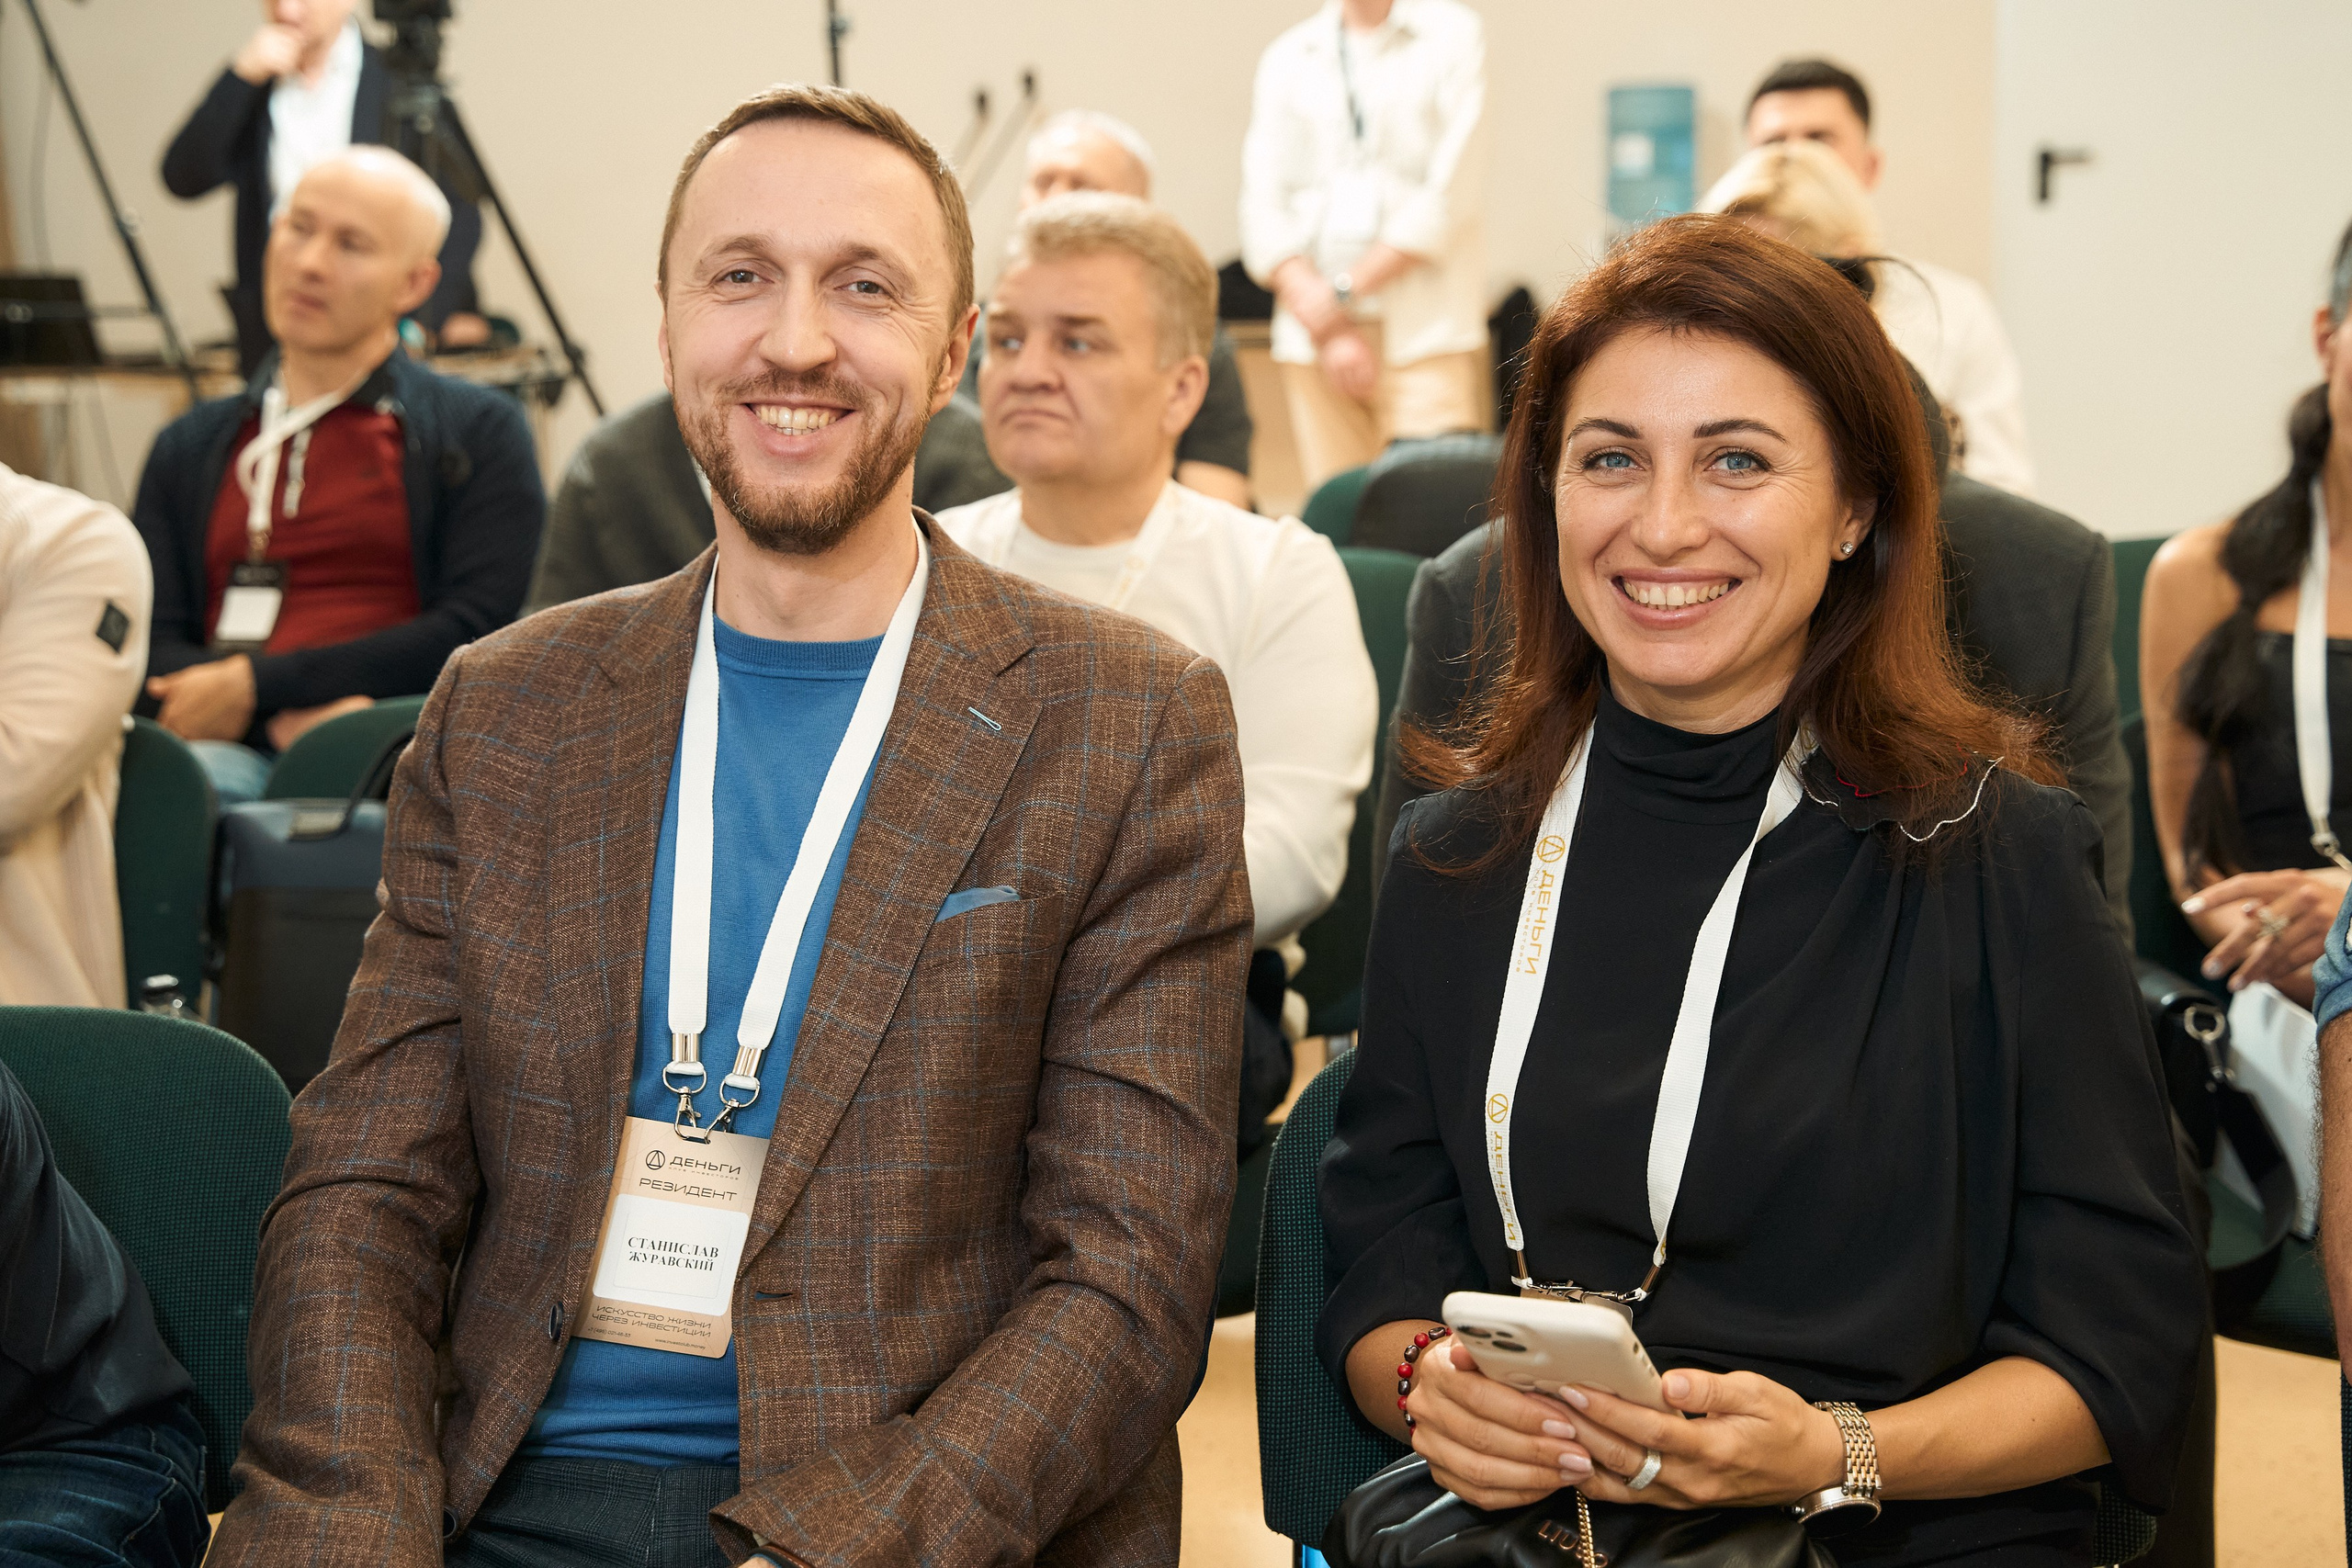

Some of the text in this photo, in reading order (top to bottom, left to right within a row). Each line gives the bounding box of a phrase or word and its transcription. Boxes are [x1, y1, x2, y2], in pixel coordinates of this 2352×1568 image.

[1524, 870, 1555, 975] ДЕНЬГИ
[670, 1156, 741, 1175] ДЕНЬГИ
[639, 1178, 738, 1201] РЕЗИДЕНТ
[628, 1236, 719, 1258] СТАНИСЛАВ
[628, 1251, 714, 1271] ЖУРАВСКИЙ
[592, 1313, 711, 1337] ЧЕРЕЗ ИНВЕСТИЦИИ
[596, 1304, 711, 1329] ИСКУССТВО ЖИЗНИ
[1538, 1519, 1579, 1551] LIU
